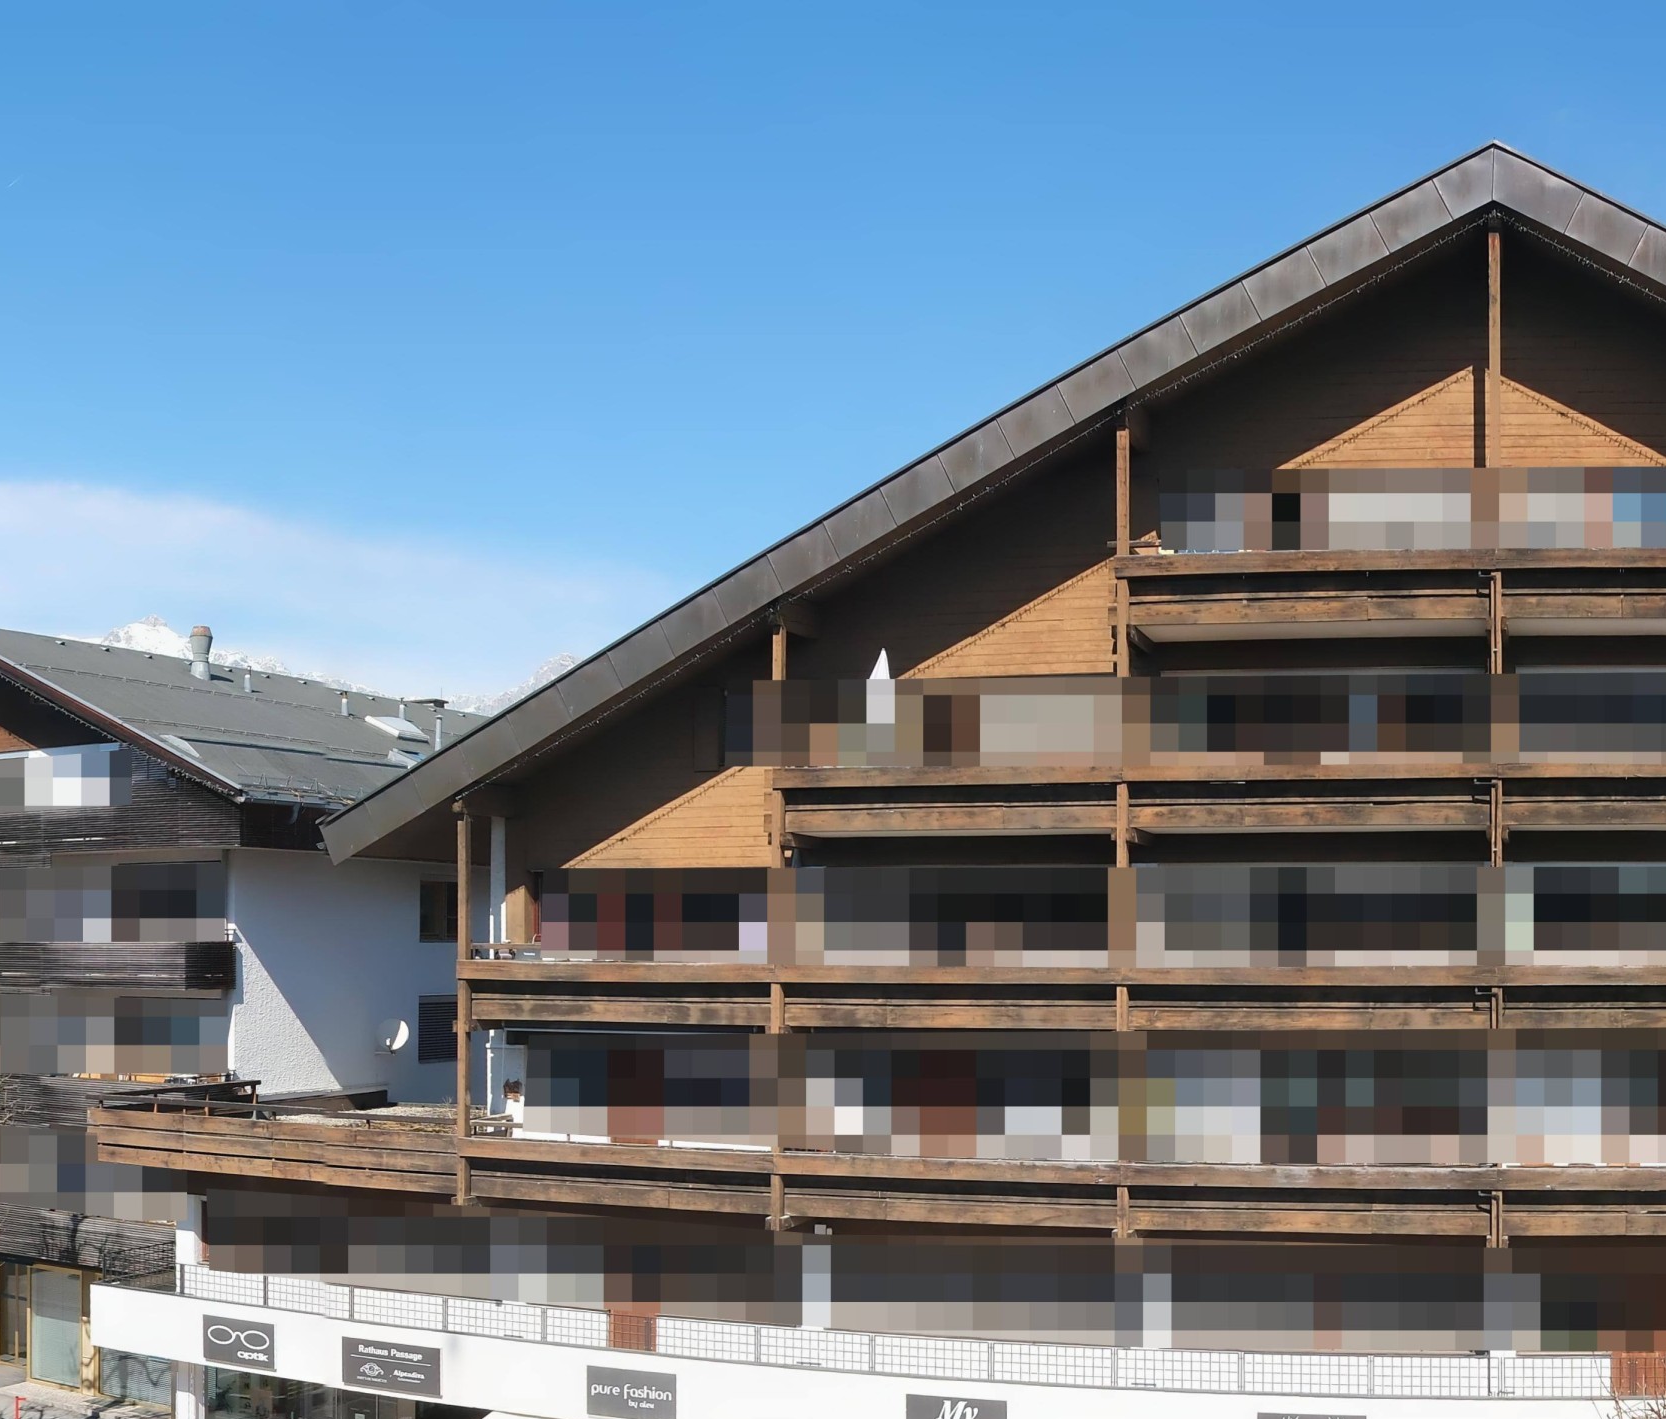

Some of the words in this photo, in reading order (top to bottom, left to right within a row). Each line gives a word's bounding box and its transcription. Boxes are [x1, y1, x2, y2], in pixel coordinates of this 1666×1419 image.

[237, 1350, 269, 1362] optik
[358, 1344, 389, 1356] Rathaus
[390, 1348, 423, 1362] Passage
[591, 1384, 621, 1396] pure
[628, 1400, 638, 1409] by
